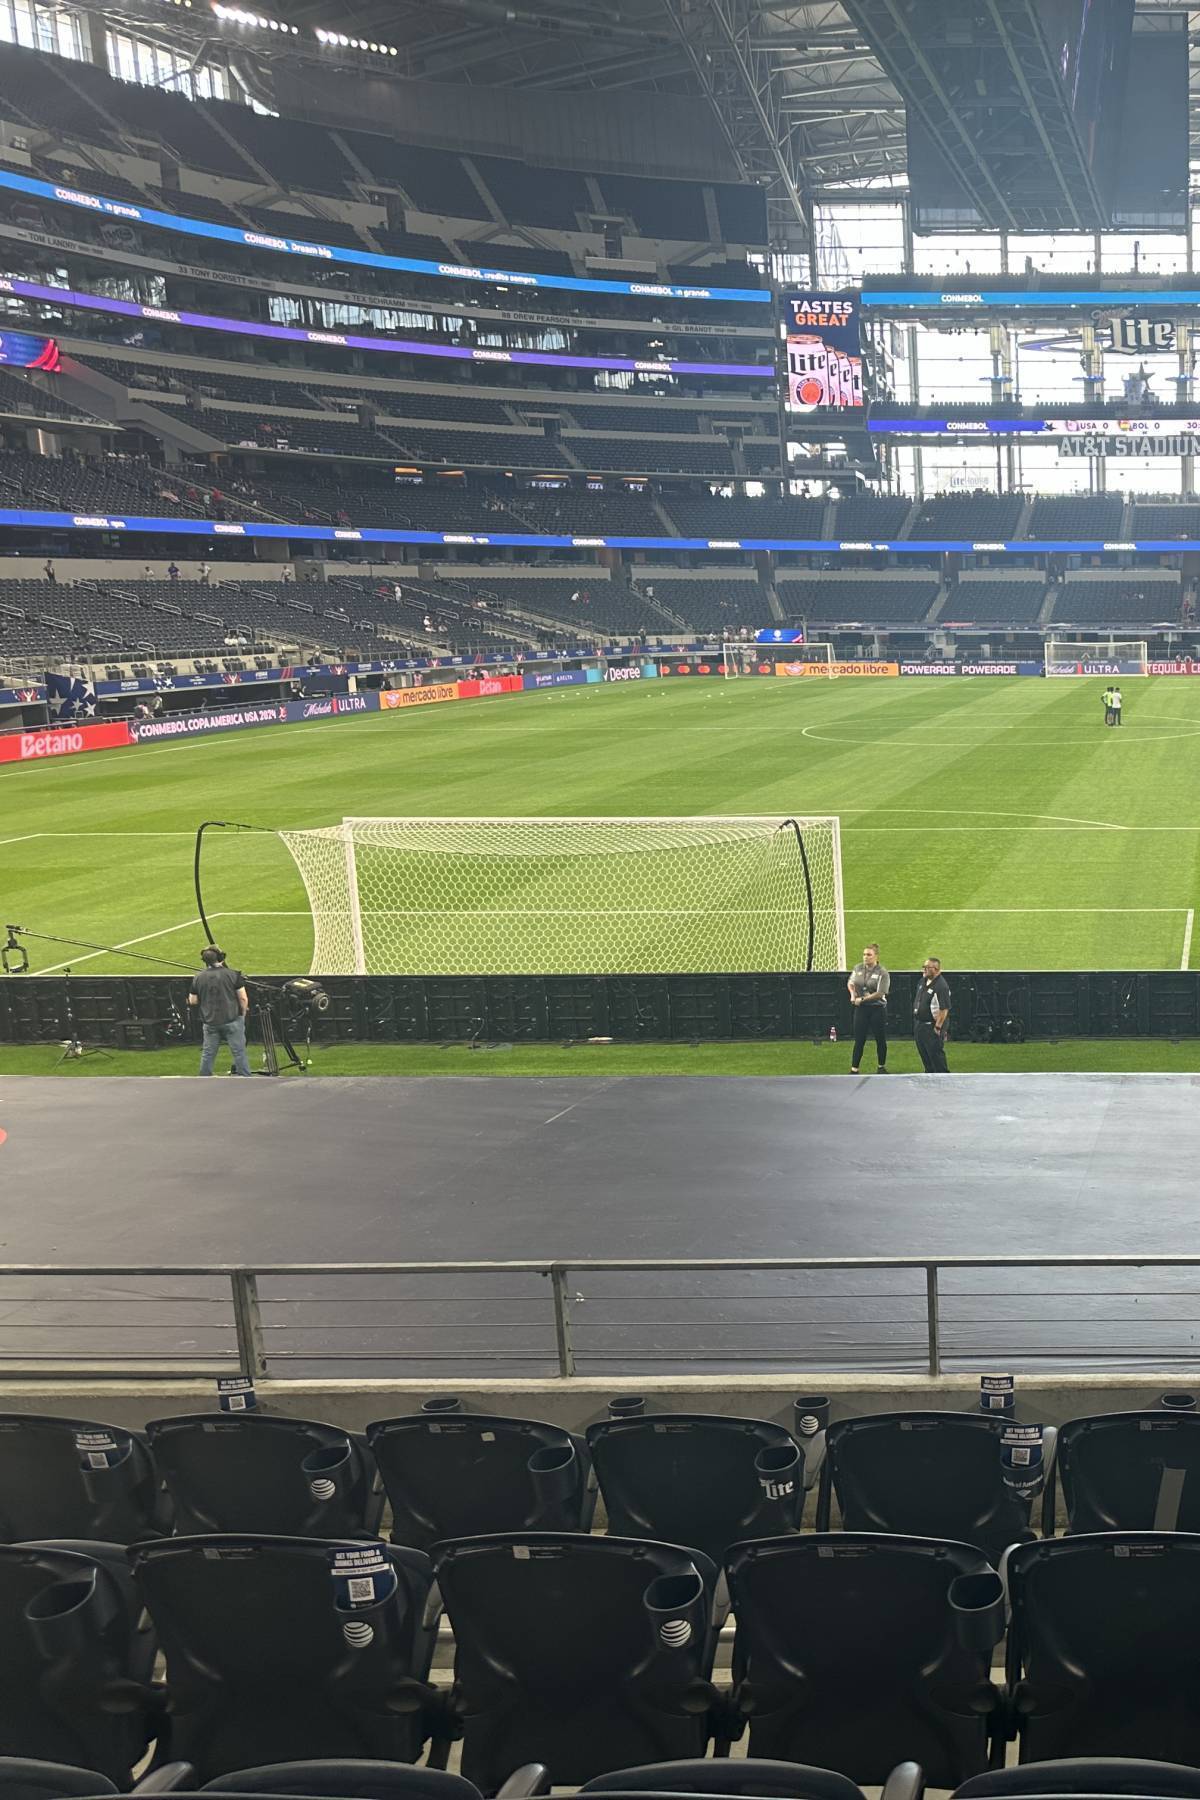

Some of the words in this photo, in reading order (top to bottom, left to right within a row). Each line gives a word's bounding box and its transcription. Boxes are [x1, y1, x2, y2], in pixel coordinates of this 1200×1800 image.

[55, 188, 102, 208] CONMEBOL
[244, 233, 288, 249] CONMEBOL
[190, 268, 210, 279] TONY
[212, 271, 247, 285] DORSETT
[439, 265, 483, 278] CONMEBOL
[631, 285, 673, 295] CONMEBOL
[942, 294, 983, 303] CONMEBOL
[791, 300, 853, 314] TASTES
[513, 313, 535, 322] DREW
[536, 315, 570, 325] PEARSON
[795, 313, 848, 326] GREAT
[1107, 317, 1173, 355] Lite
[472, 350, 512, 360] CONMEBOL
[634, 362, 672, 371] CONMEBOL
[790, 352, 826, 376] Lite
[946, 422, 988, 431] CONMEBOL
[1080, 421, 1098, 430] USA
[1103, 421, 1109, 430] 0
[1132, 421, 1149, 431] BOL
[1154, 421, 1160, 430] 0
[1059, 436, 1110, 456] AT&T
[609, 667, 641, 682] Degree
[863, 664, 889, 675] libre
[901, 665, 956, 675] POWERADE
[961, 665, 1017, 675] POWERADE
[1084, 665, 1119, 674] ULTRA
[1148, 663, 1187, 674] TEQUILA
[402, 688, 437, 702] mercado
[437, 686, 454, 699] libre
[302, 702, 332, 718] Michelob
[338, 697, 367, 711] ULTRA
[139, 718, 187, 738] CONMEBOL
[188, 717, 209, 732] COPA
[244, 712, 258, 724] USA
[259, 709, 277, 721] 2024
[20, 731, 83, 758] Betano
[760, 1480, 794, 1500] Lite
